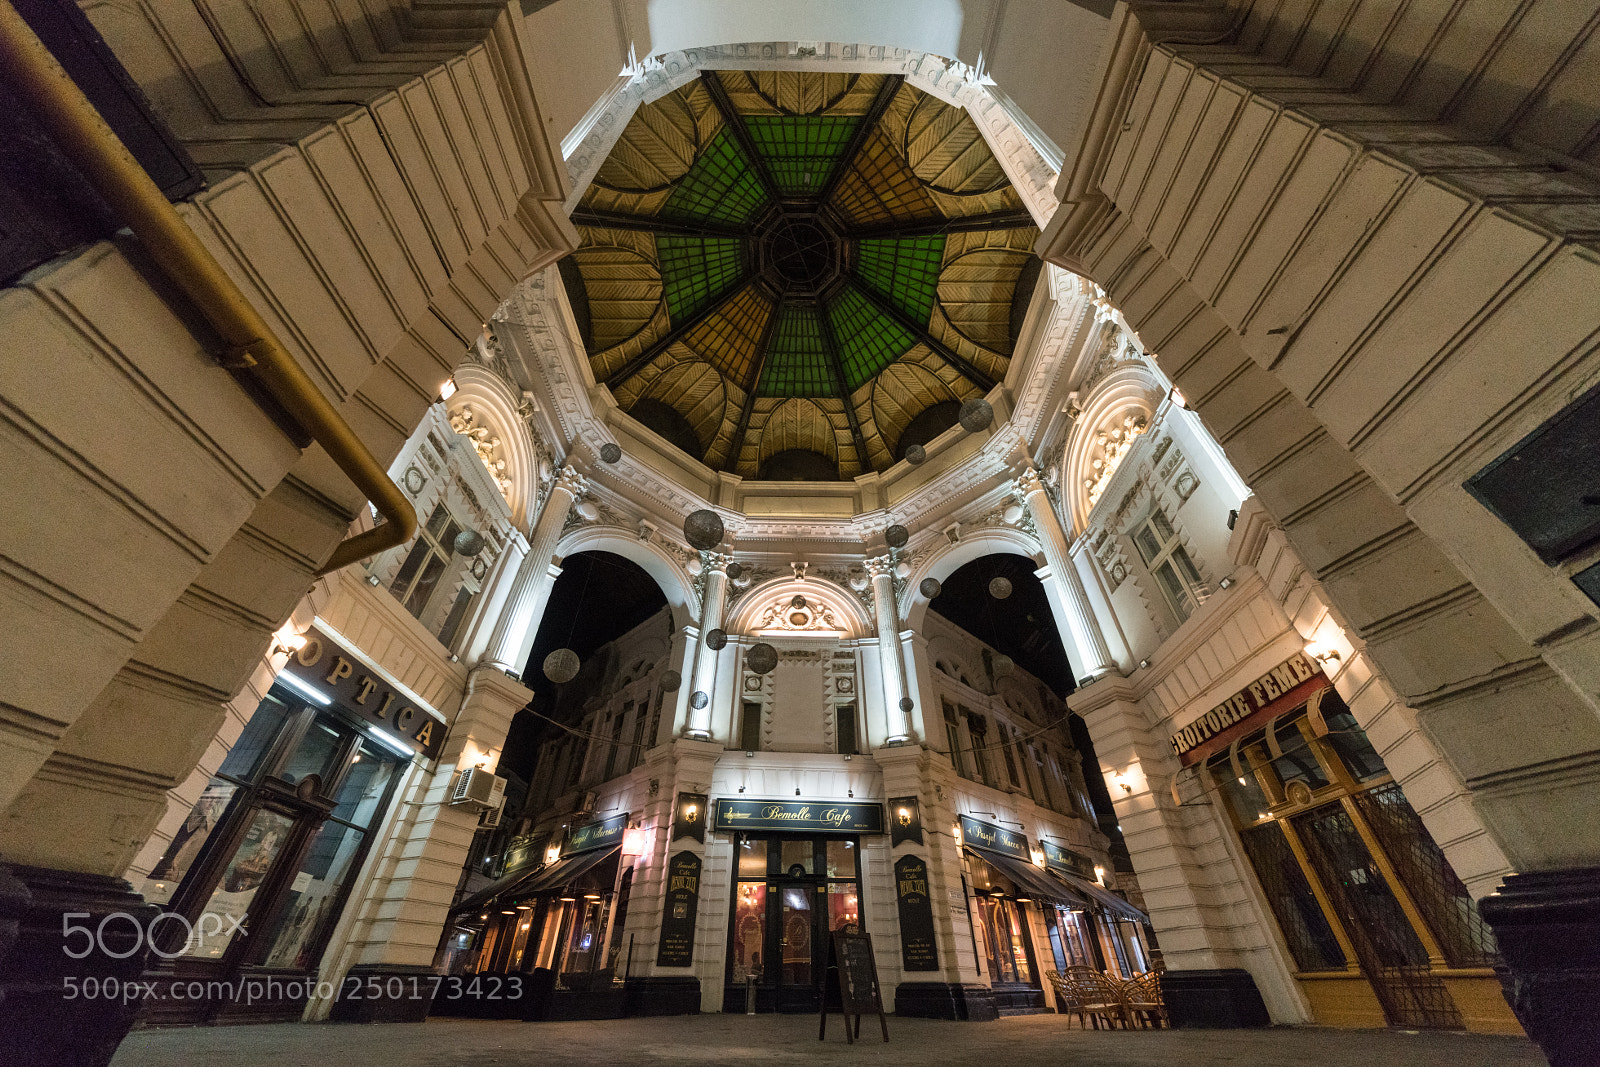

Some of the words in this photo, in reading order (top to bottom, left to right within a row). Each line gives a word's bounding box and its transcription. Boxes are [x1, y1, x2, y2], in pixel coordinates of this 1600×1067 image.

[298, 637, 434, 747] OPTICA
[761, 805, 811, 820] Bemolle
[819, 808, 852, 827] Cafe
